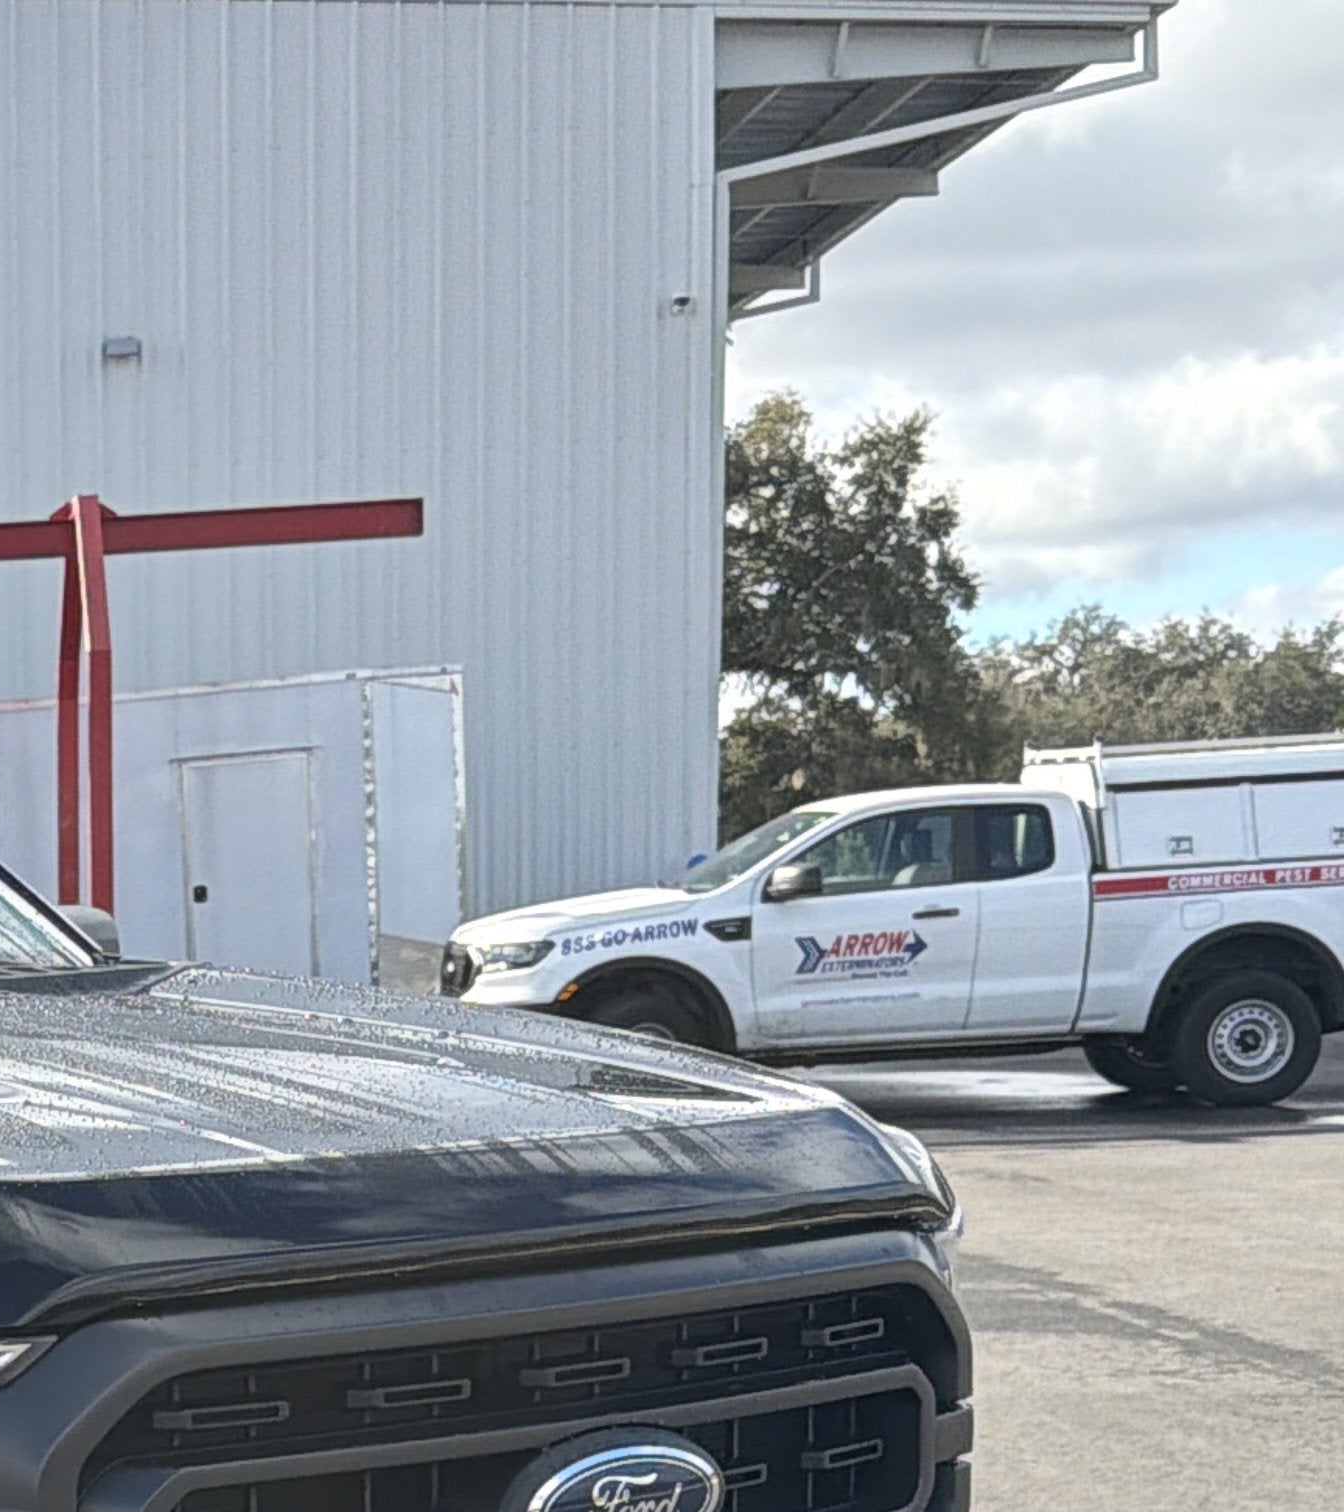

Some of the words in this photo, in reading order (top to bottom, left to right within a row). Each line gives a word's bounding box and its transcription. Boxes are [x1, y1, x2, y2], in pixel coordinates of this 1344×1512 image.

[1167, 869, 1267, 890] COMMERCIAL
[1274, 868, 1312, 884] PEST
[826, 929, 911, 959] ARROW
